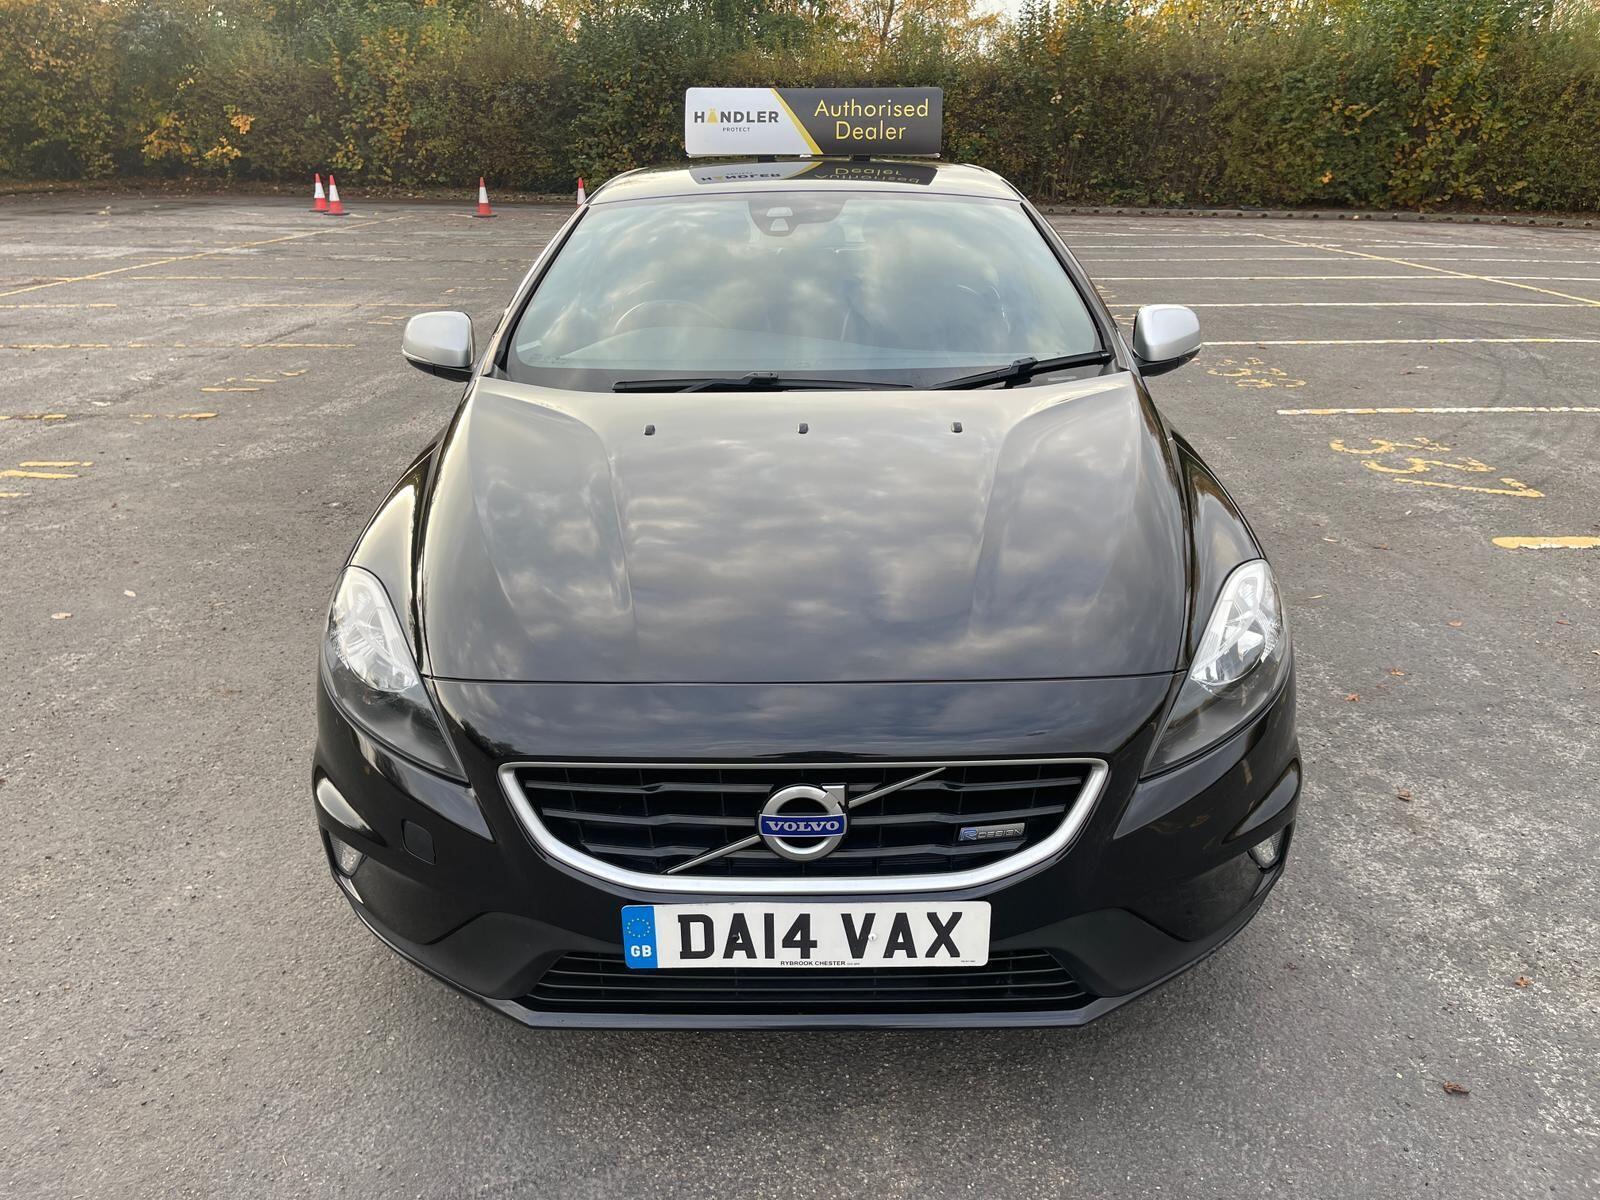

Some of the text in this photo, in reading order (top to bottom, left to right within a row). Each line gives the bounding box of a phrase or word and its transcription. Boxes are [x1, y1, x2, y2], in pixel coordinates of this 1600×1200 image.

[814, 98, 929, 118] Authorised
[836, 121, 906, 140] Dealer
[765, 820, 840, 832] VOLVO
[677, 911, 963, 960] DA14 VAX
[630, 944, 652, 958] GB
